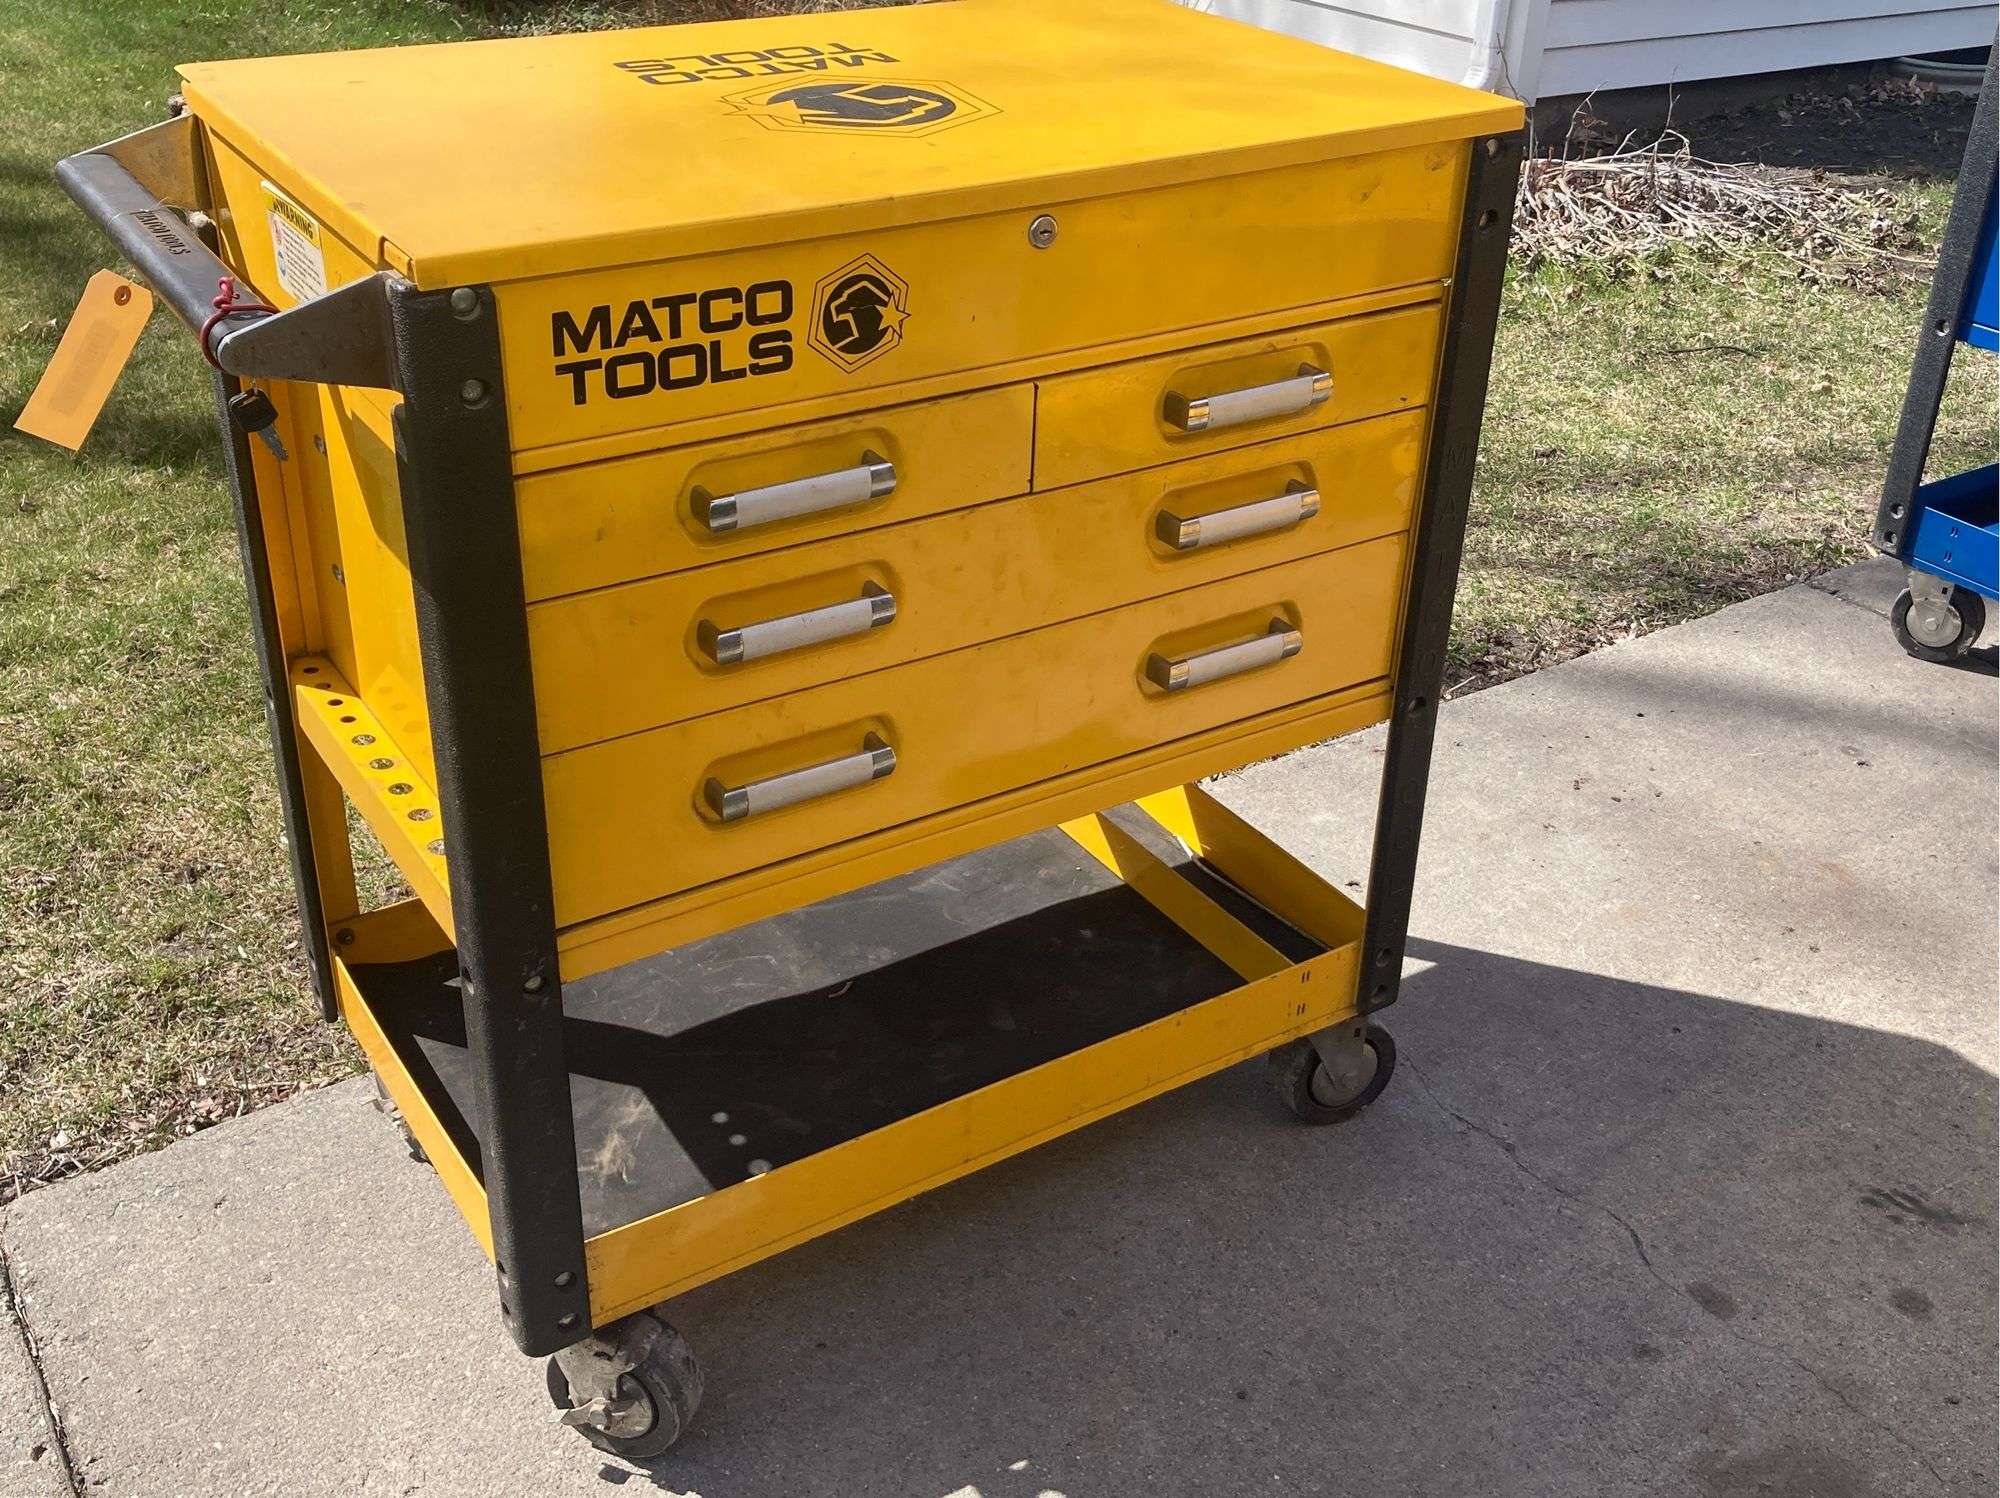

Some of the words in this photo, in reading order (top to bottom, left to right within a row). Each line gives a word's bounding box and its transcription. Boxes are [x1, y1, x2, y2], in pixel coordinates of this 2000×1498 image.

[613, 42, 873, 73] TOOLS
[637, 51, 900, 85] MATCO
[276, 198, 313, 240] WARNING
[551, 279, 794, 357] MATCO
[554, 329, 794, 405] TOOLS
